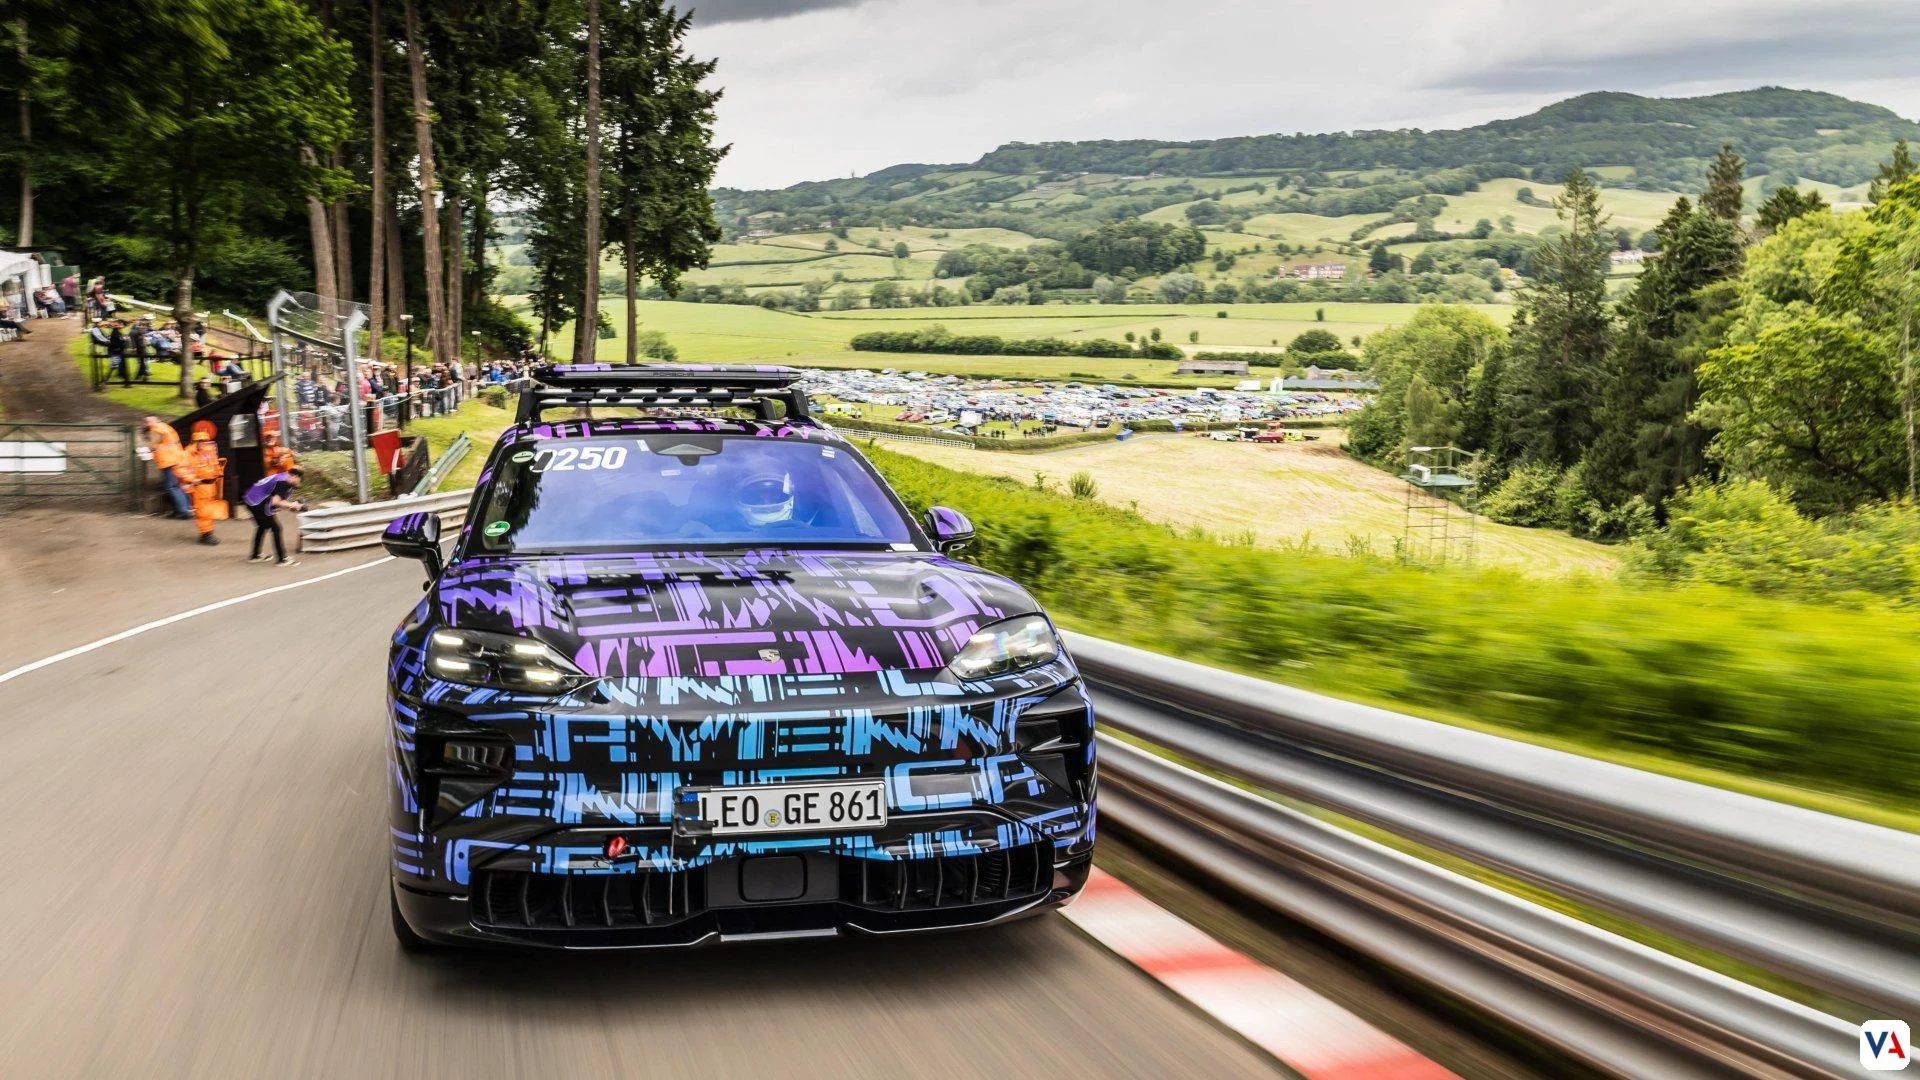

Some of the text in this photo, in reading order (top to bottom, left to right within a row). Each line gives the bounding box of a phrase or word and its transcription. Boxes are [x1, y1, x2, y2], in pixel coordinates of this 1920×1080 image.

[529, 446, 628, 473] 0250
[701, 795, 760, 828] LEO
[783, 792, 821, 825] GE
[829, 789, 882, 823] 861
